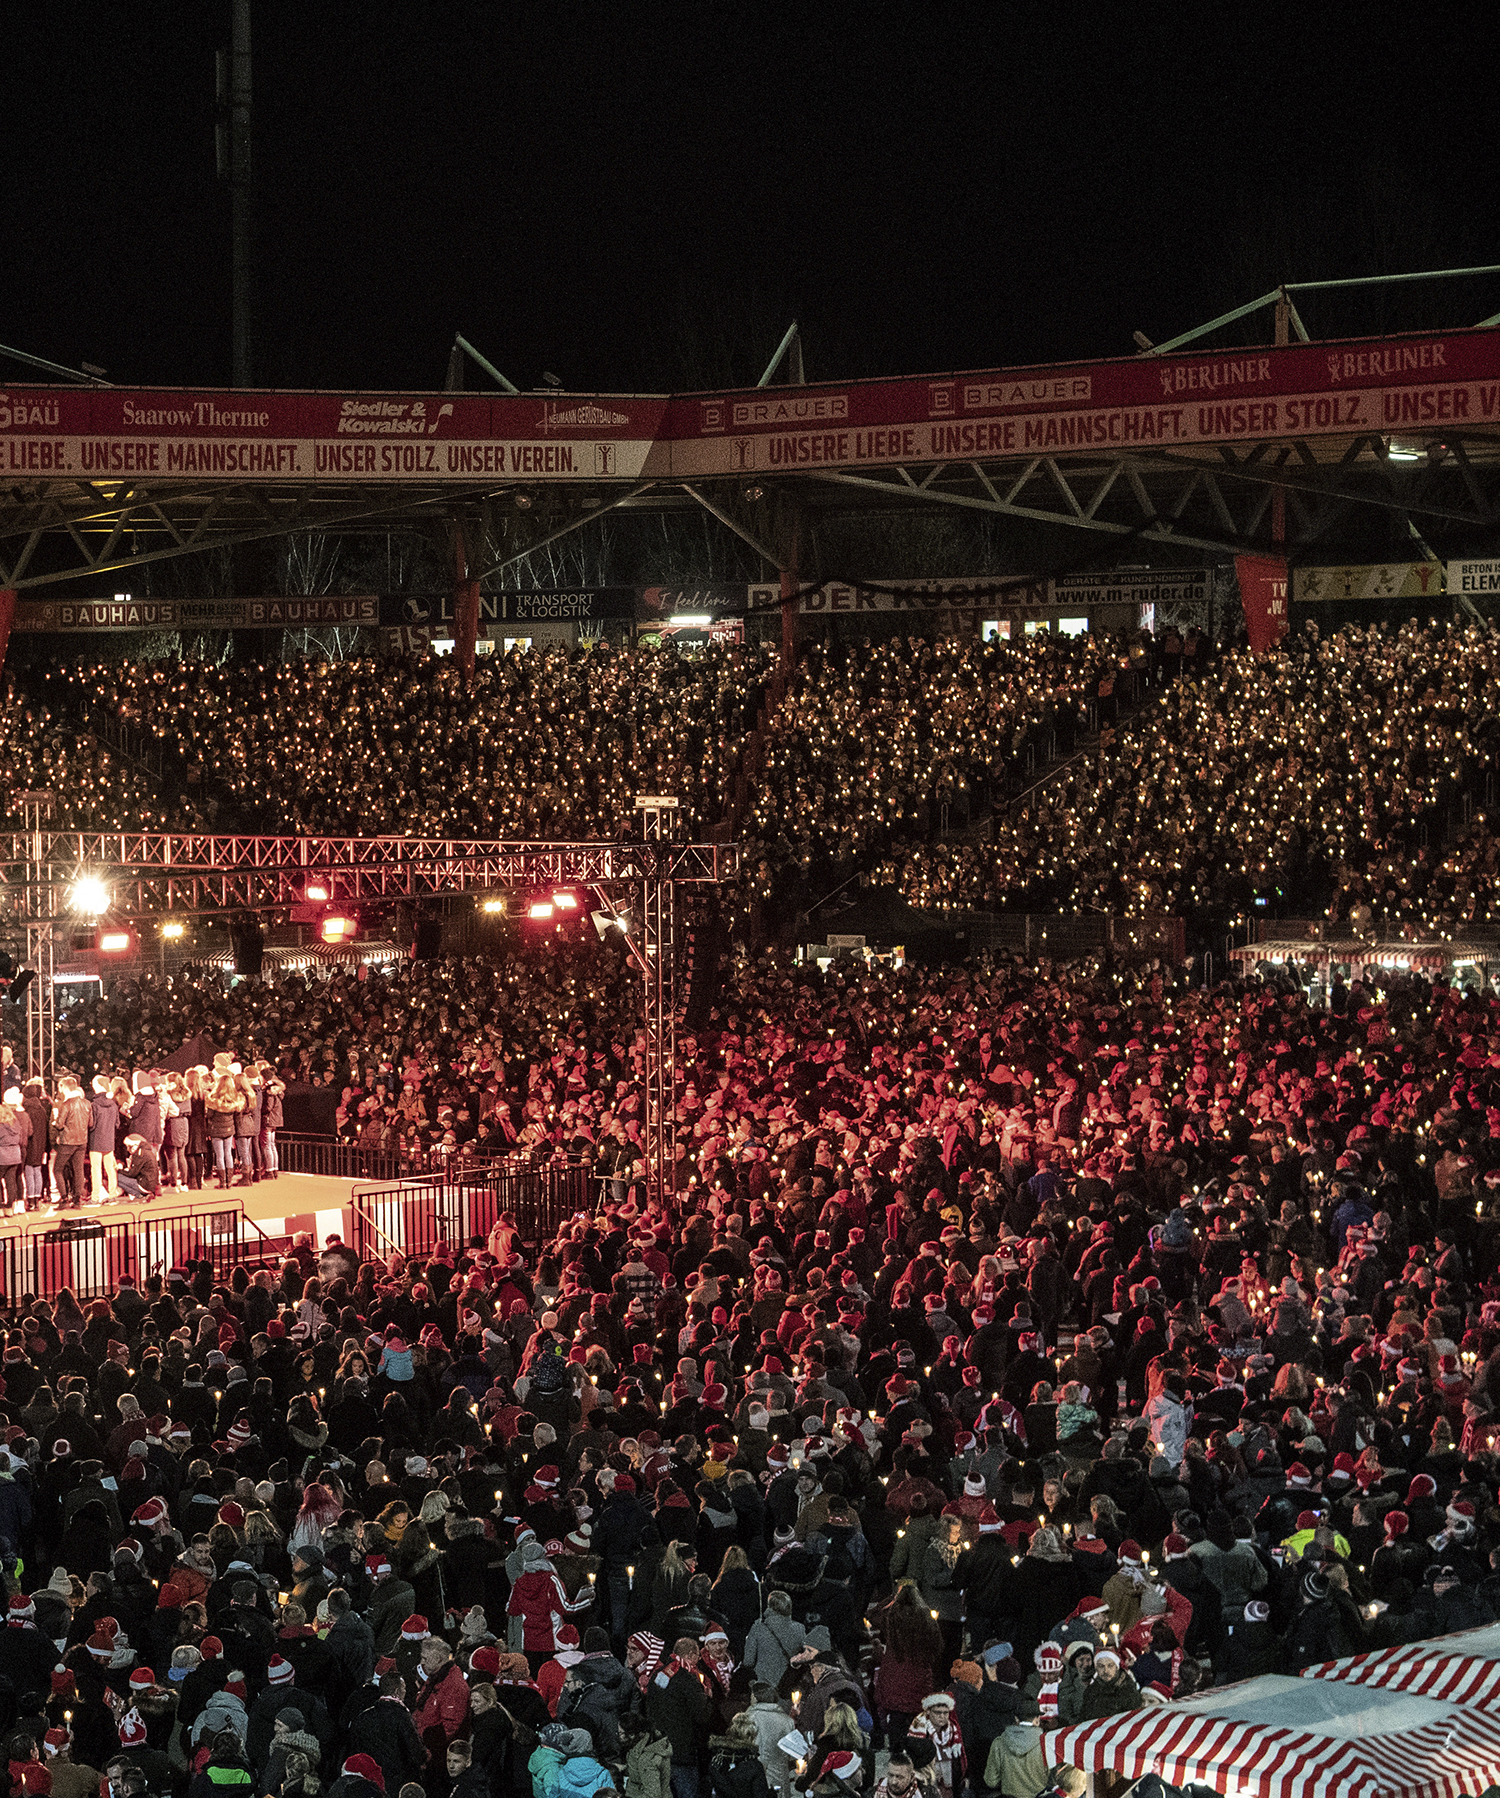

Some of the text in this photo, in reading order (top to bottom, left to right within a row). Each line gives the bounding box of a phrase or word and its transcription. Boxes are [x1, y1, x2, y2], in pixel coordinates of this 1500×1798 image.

[1345, 344, 1448, 377] BERLINER
[1175, 358, 1271, 390] BERLINER
[967, 381, 1089, 404] BRAUER
[123, 400, 270, 427] SaarowTherme
[341, 400, 427, 416] Siedler &
[736, 400, 846, 422] BRAUER
[337, 417, 426, 433] Kowalski
[769, 434, 848, 464] UNSERE
[856, 429, 922, 459] LIEBE.
[931, 422, 1016, 453] UNSERE
[1025, 410, 1187, 447] MANNSCHAFT.
[1199, 400, 1277, 435] UNSER
[1285, 397, 1368, 430] STOLZ.
[1384, 389, 1468, 423] UNSER
[10, 441, 72, 470] LIEBE.
[81, 442, 159, 471] UNSERE
[167, 443, 301, 472] MANNSCHAFT.
[315, 444, 376, 472] UNSER
[381, 445, 440, 472] STOLZ.
[448, 446, 505, 472] UNSER
[511, 446, 578, 472] VEREIN.
[1462, 564, 1493, 574] BETON
[752, 588, 878, 611] RDER
[1055, 584, 1204, 603] www.m-ruder.de
[62, 605, 173, 623] BAUHAUS
[253, 601, 375, 620] BAUHAUS
[441, 593, 595, 620] LNI TRANSPORT
[516, 605, 591, 618] & LOGISTIK
